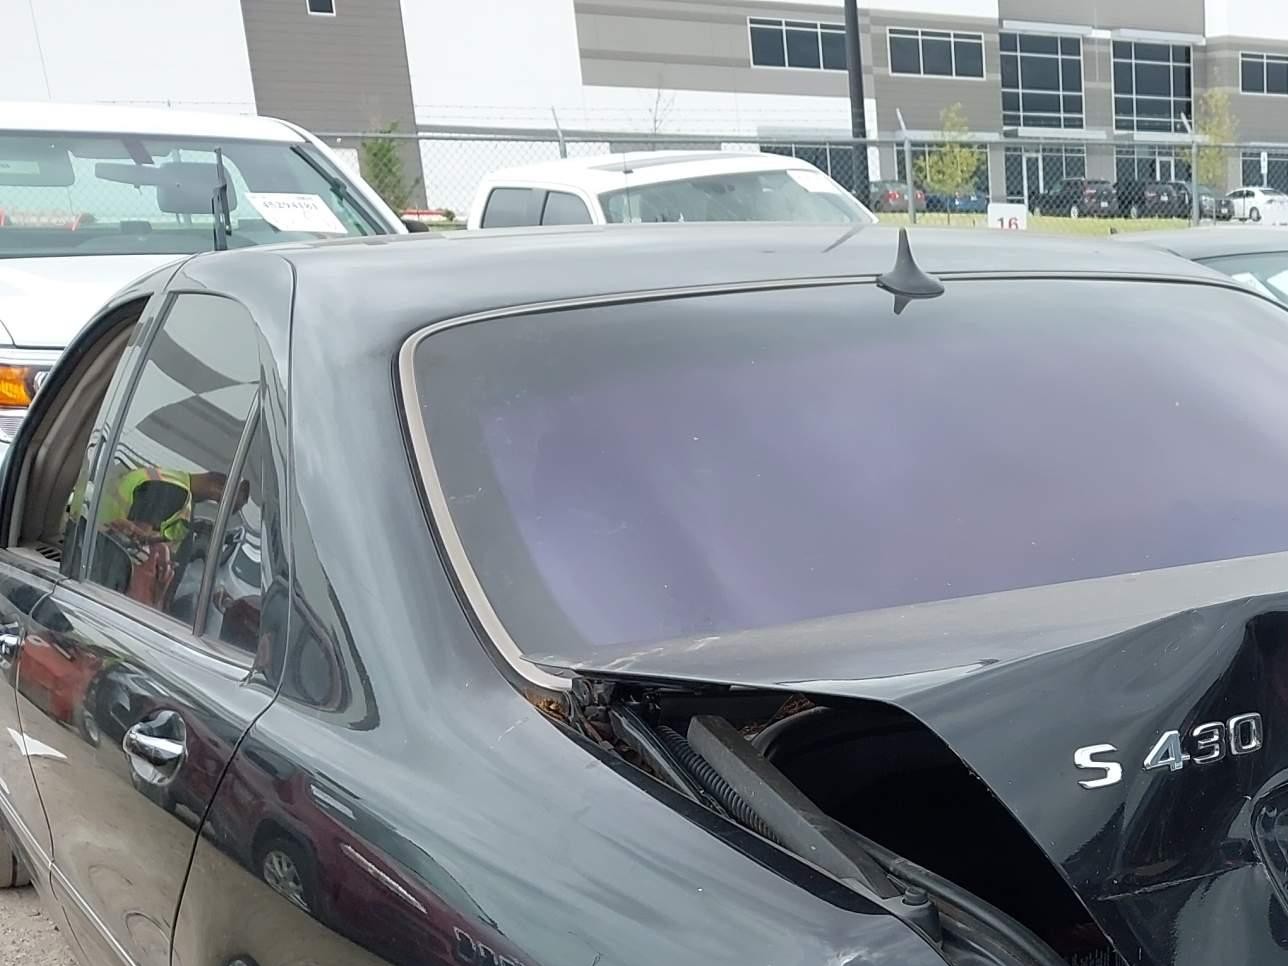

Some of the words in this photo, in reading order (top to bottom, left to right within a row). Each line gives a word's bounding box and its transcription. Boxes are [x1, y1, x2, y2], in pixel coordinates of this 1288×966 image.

[997, 216, 1019, 230] 16
[1073, 743, 1123, 790] S
[1142, 711, 1264, 772] 430
